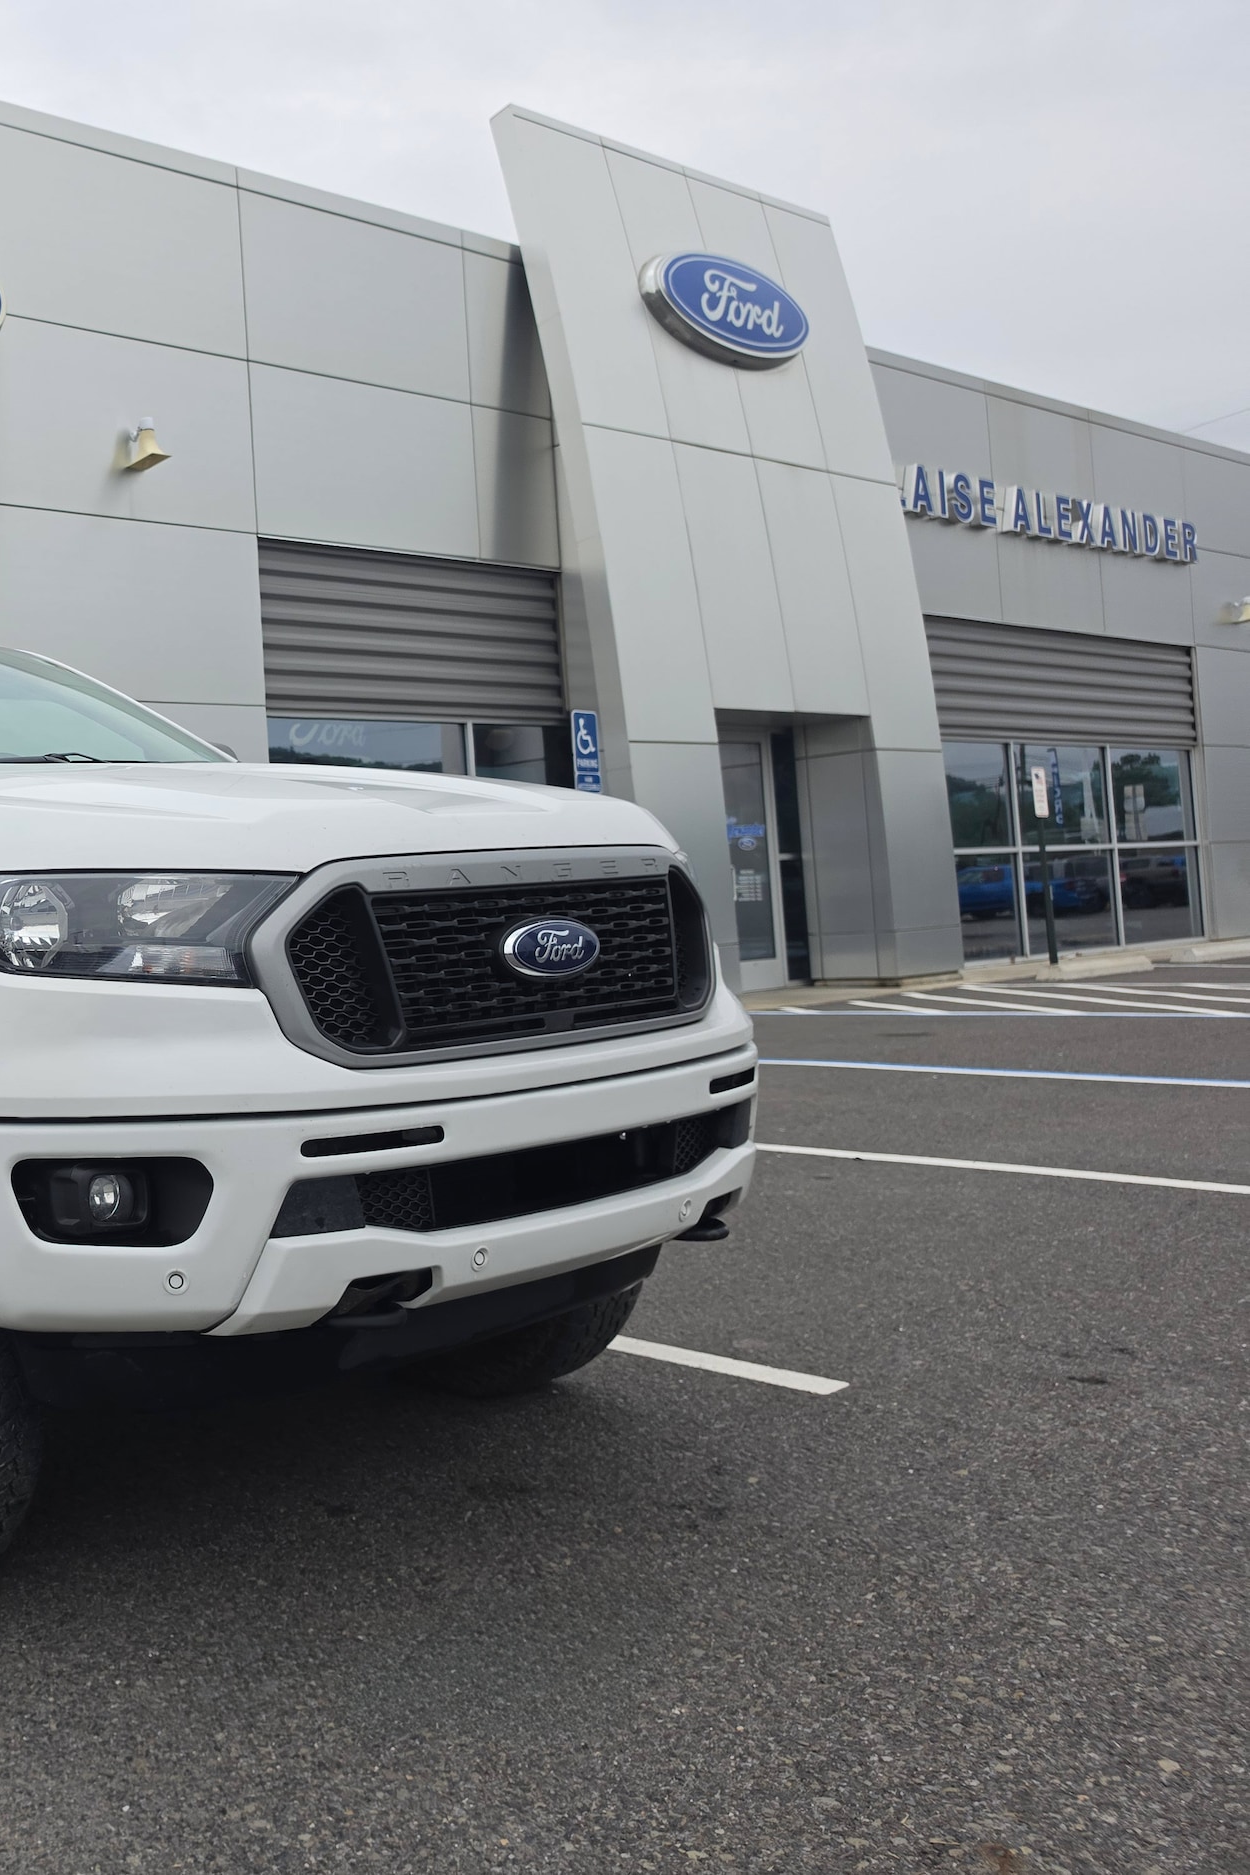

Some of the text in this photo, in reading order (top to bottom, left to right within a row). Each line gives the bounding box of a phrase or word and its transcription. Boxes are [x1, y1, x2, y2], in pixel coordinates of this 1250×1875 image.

[700, 269, 784, 338] Ford
[900, 464, 1198, 563] AISE ALEXANDER
[381, 858, 659, 890] RANGER
[534, 929, 585, 962] Ford
